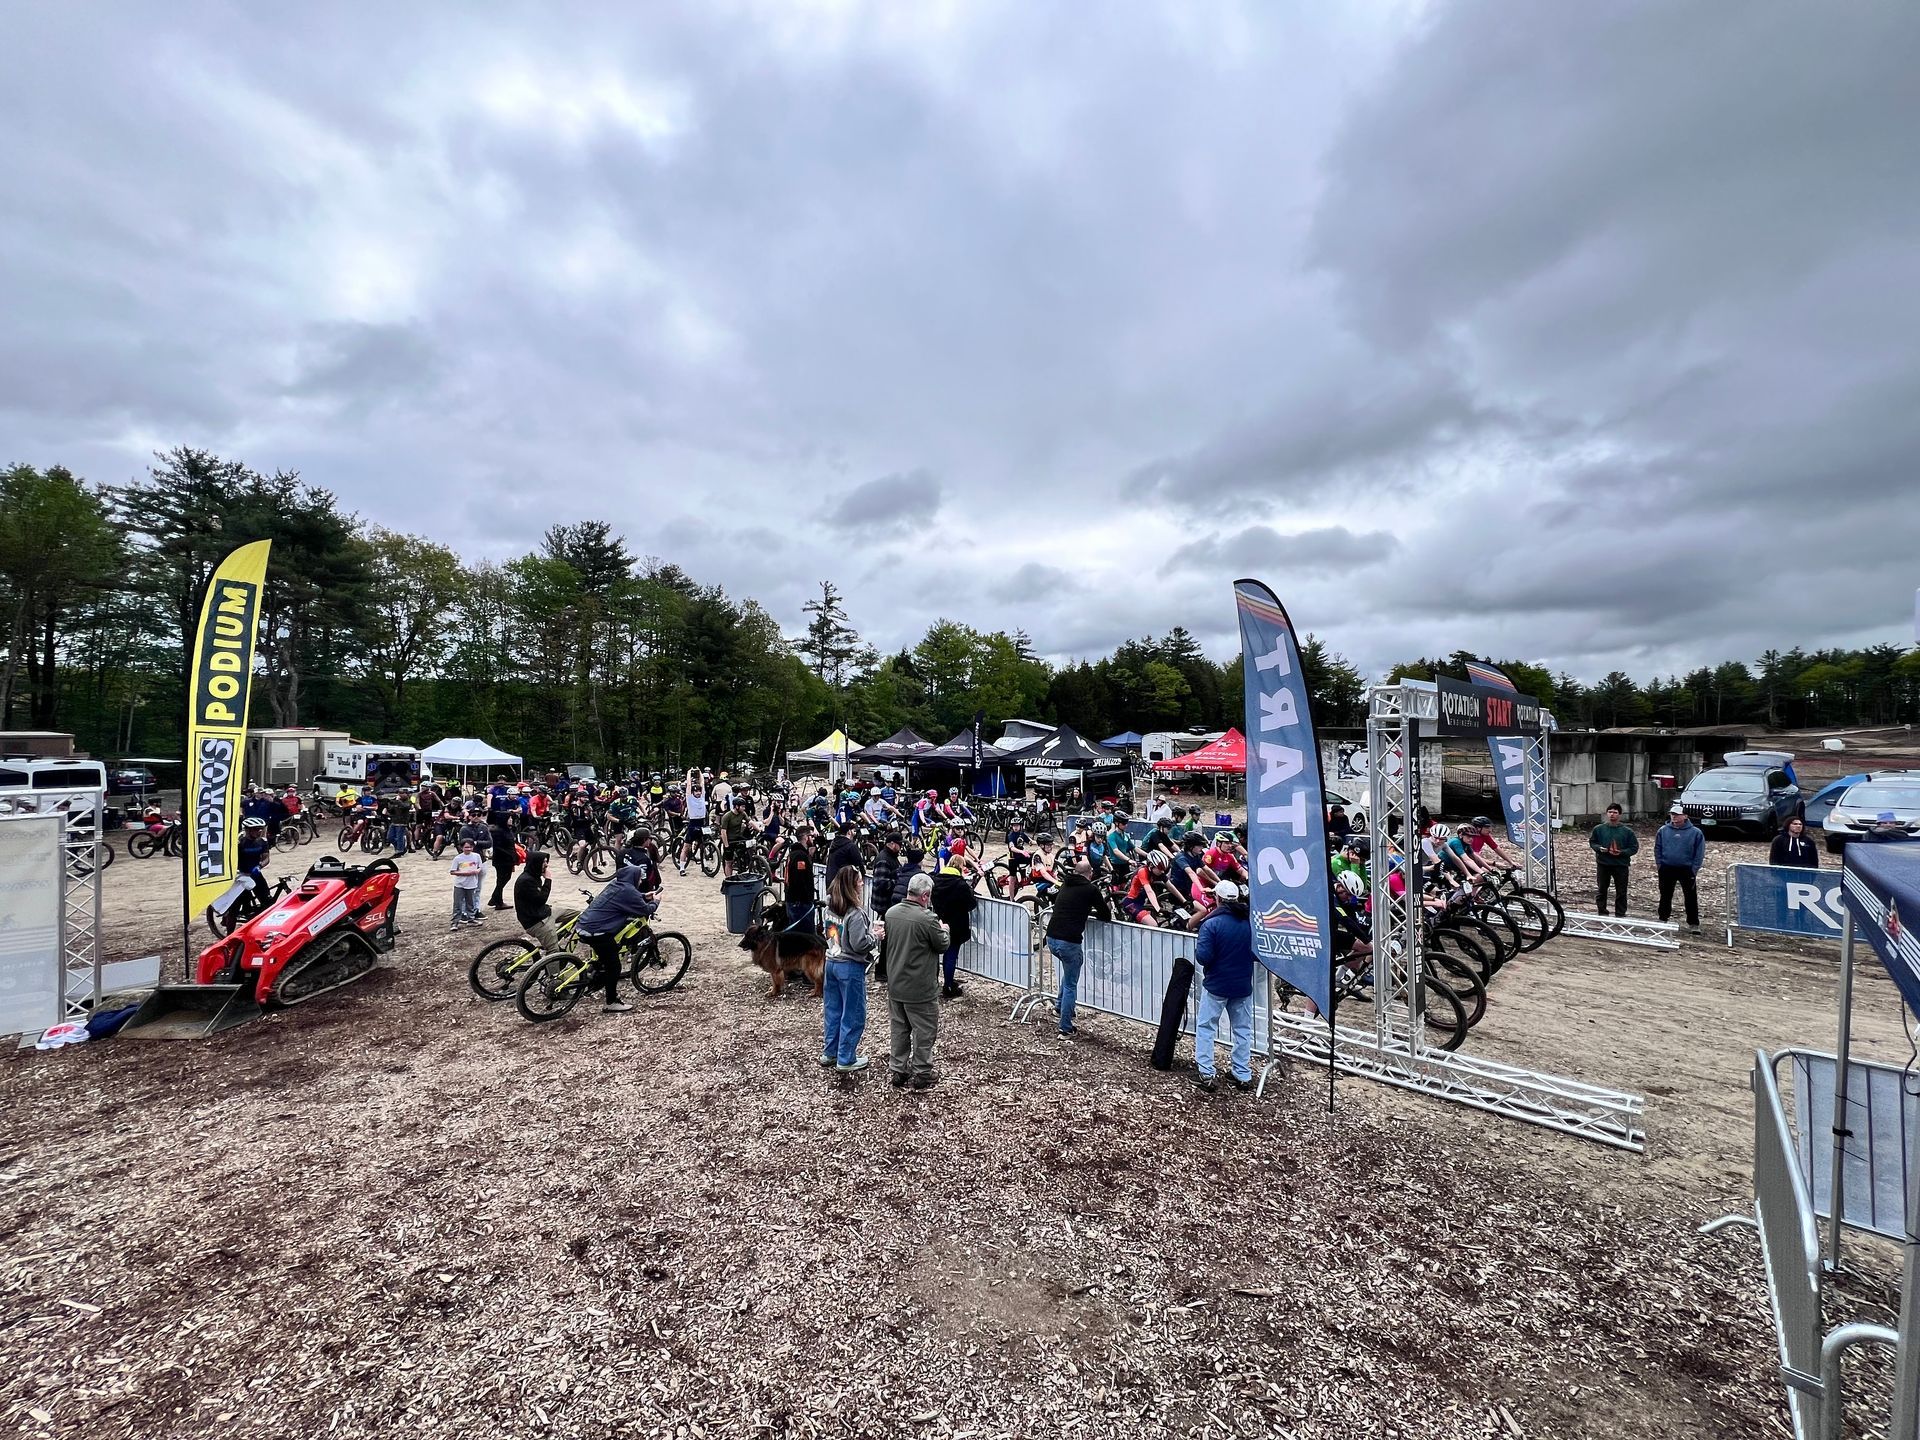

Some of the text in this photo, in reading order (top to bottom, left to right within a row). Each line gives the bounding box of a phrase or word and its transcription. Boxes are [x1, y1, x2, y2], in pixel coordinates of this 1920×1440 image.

[205, 586, 248, 721] PODIUM
[1442, 691, 1480, 726] ROTATION
[1487, 696, 1512, 728] START
[1015, 757, 1064, 767] SPECIALIZED
[365, 912, 385, 923] SCL
